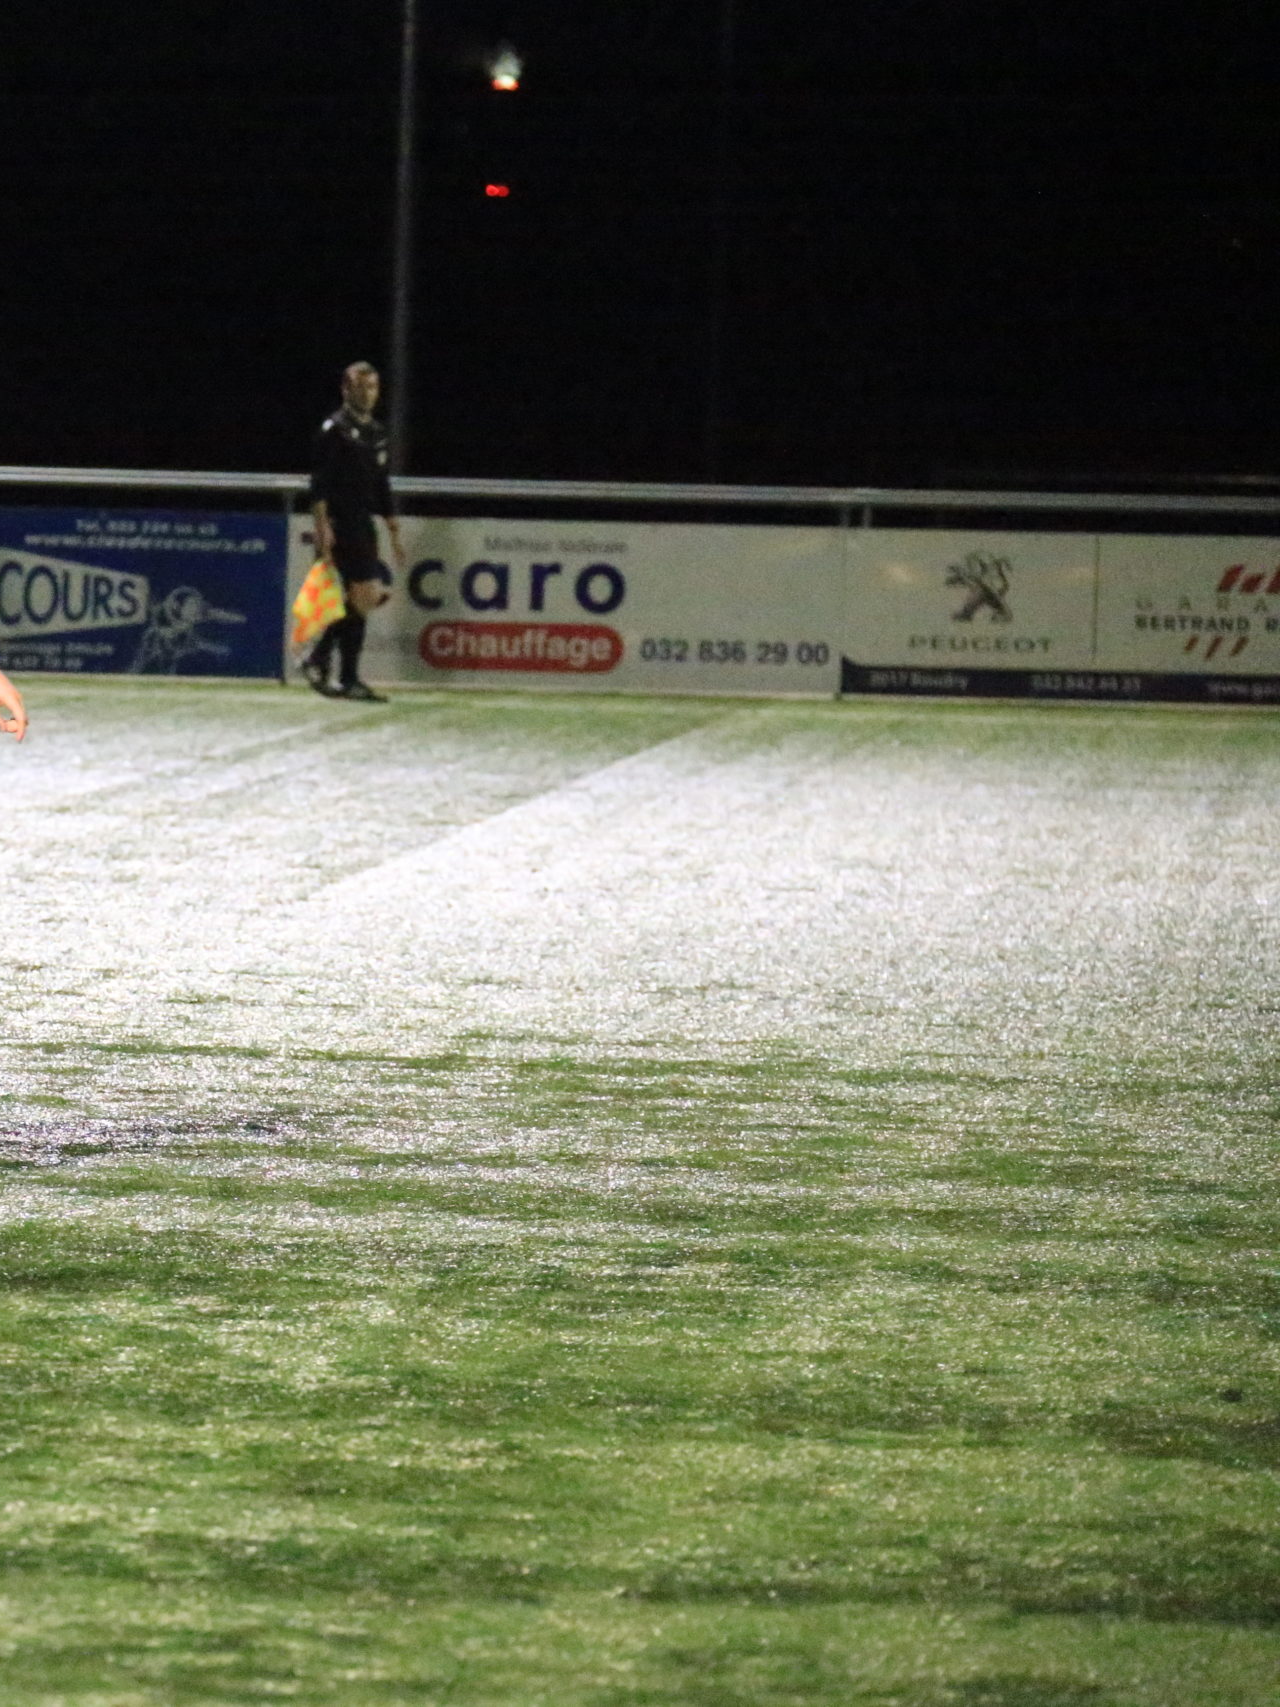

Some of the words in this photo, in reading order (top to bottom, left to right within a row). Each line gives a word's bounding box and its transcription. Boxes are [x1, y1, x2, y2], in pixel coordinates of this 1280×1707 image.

[1135, 614, 1250, 632] BERTRAND
[430, 627, 612, 666] Chauffage
[639, 638, 688, 662] 032
[699, 639, 747, 663] 836
[756, 640, 789, 665] 29
[797, 641, 830, 666] 00
[907, 634, 1053, 654] PEUGEOT
